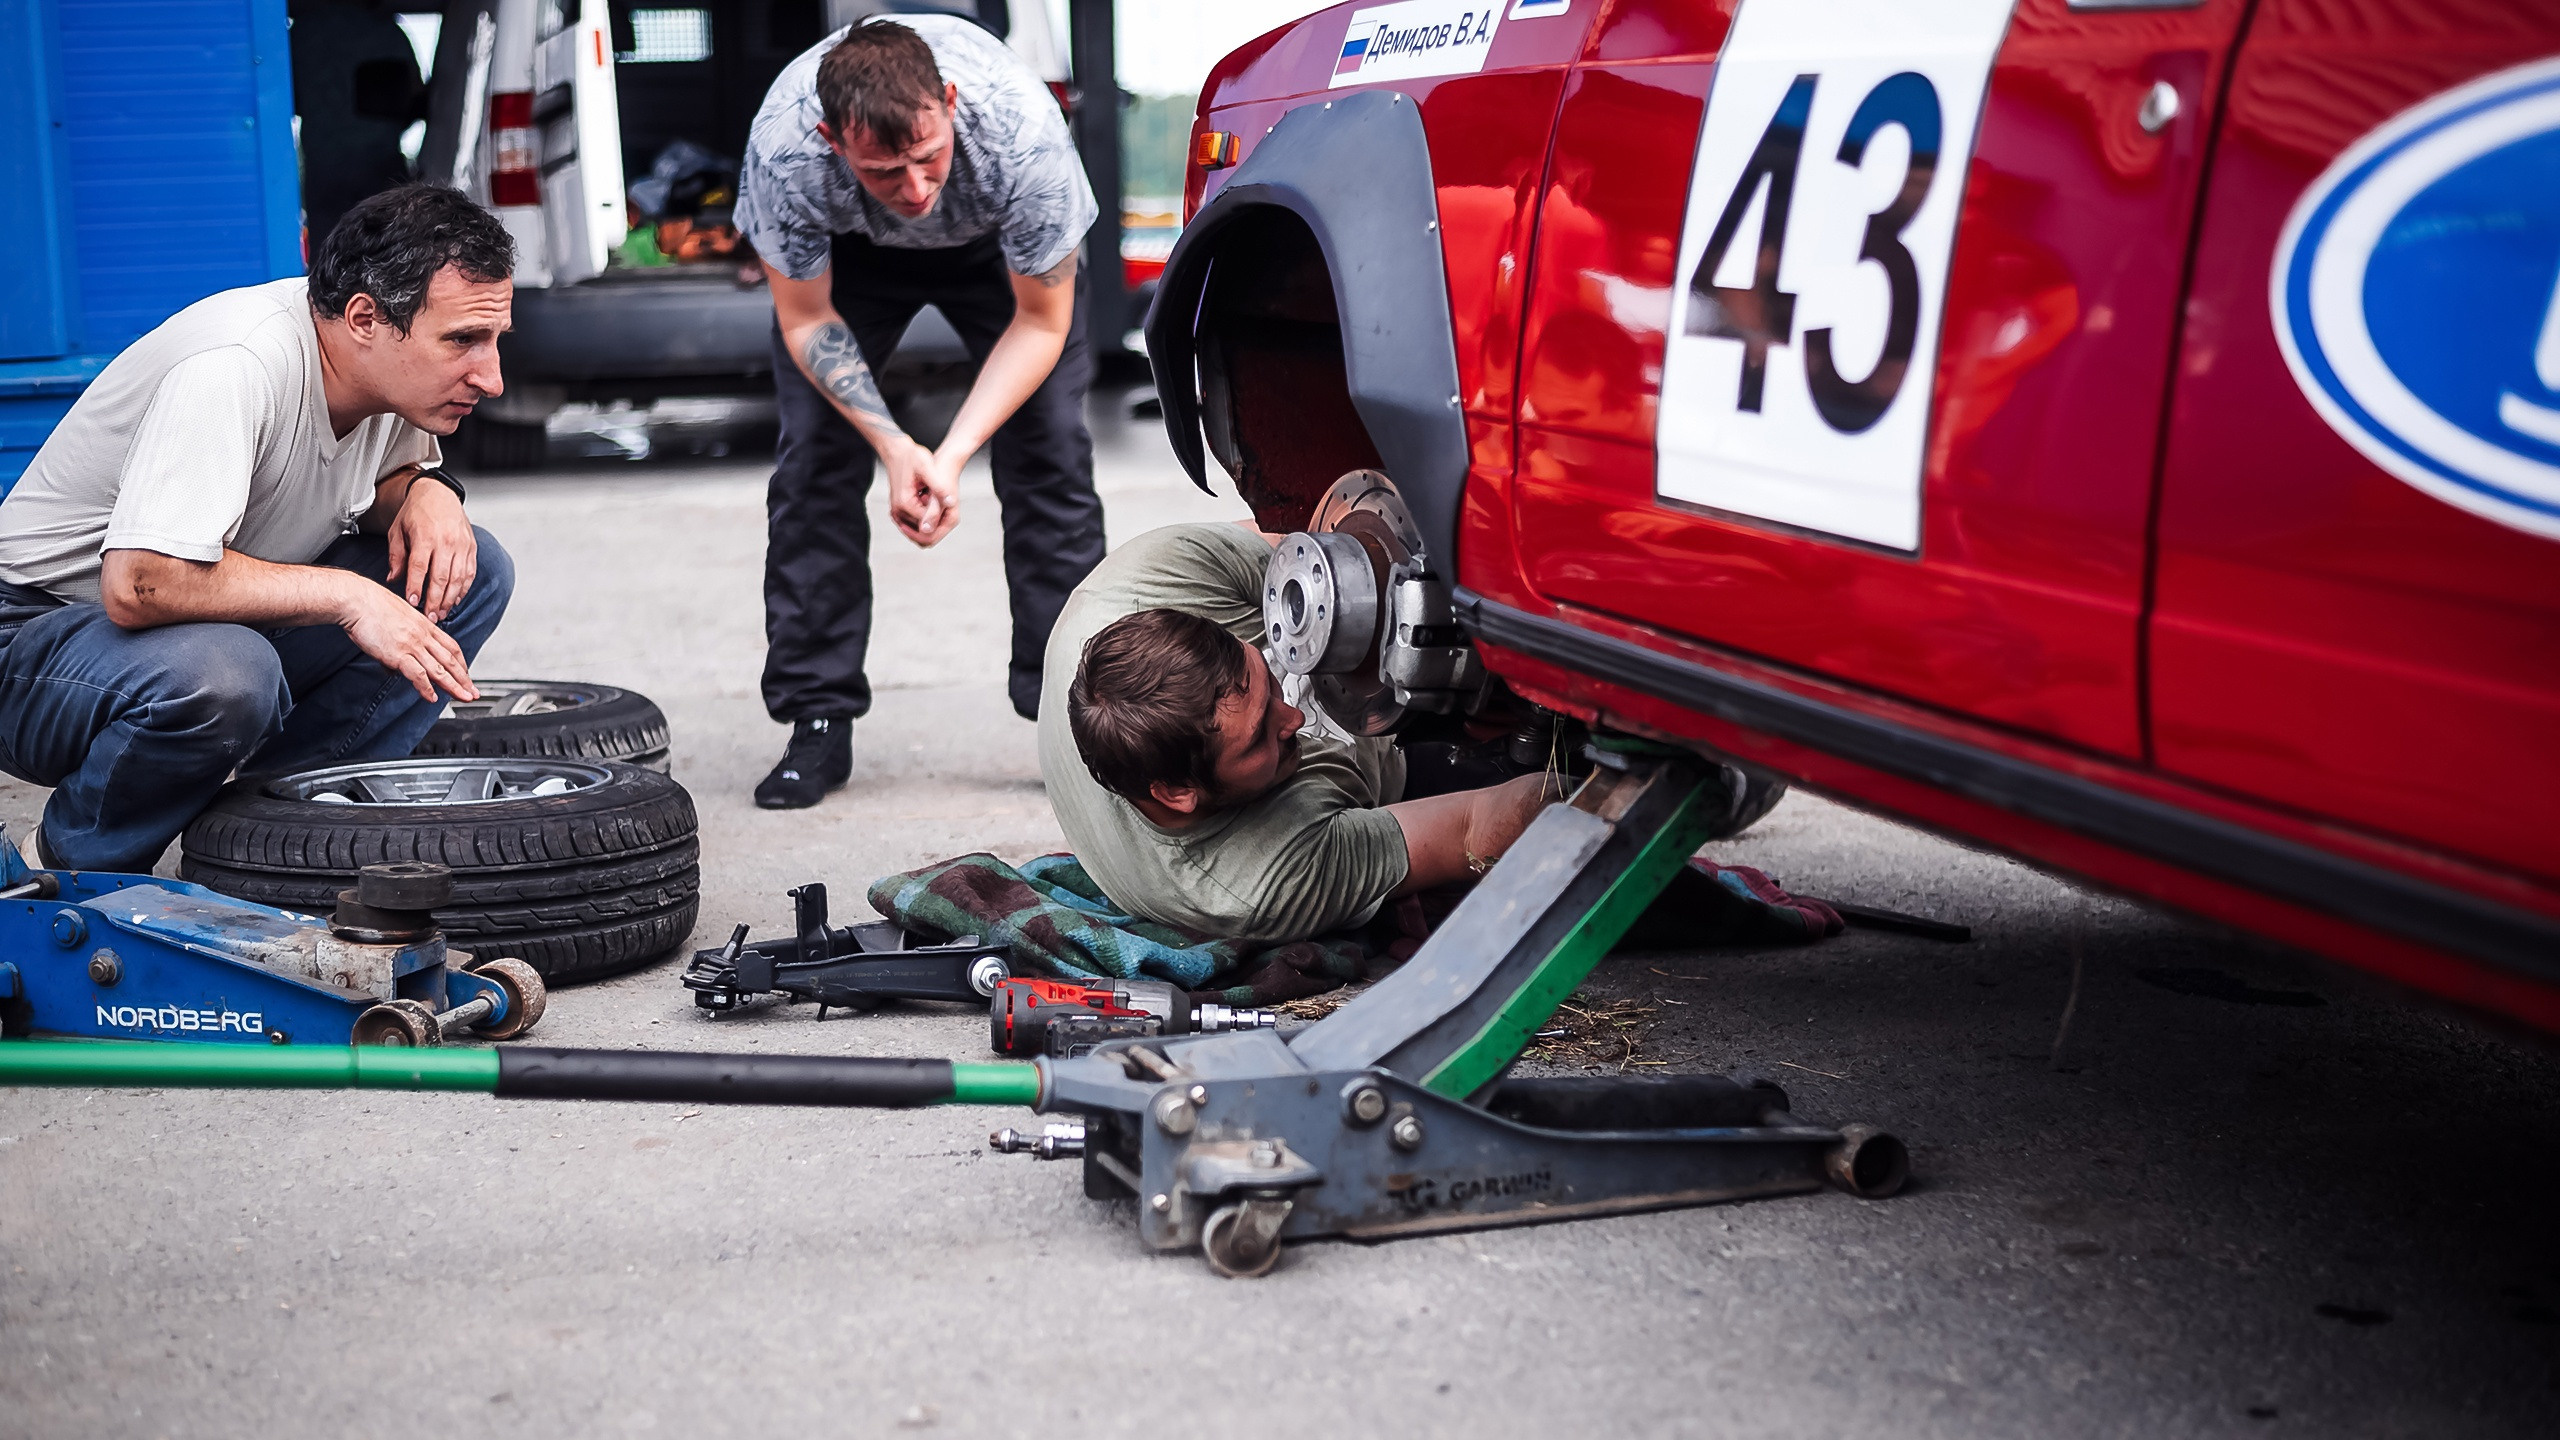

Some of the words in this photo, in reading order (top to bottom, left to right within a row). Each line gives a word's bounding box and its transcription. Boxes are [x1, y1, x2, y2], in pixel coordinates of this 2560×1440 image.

[1365, 23, 1452, 64] Демидов
[1452, 9, 1491, 46] В.А.
[1685, 72, 1942, 434] 43
[97, 1005, 263, 1033] NORDBERG
